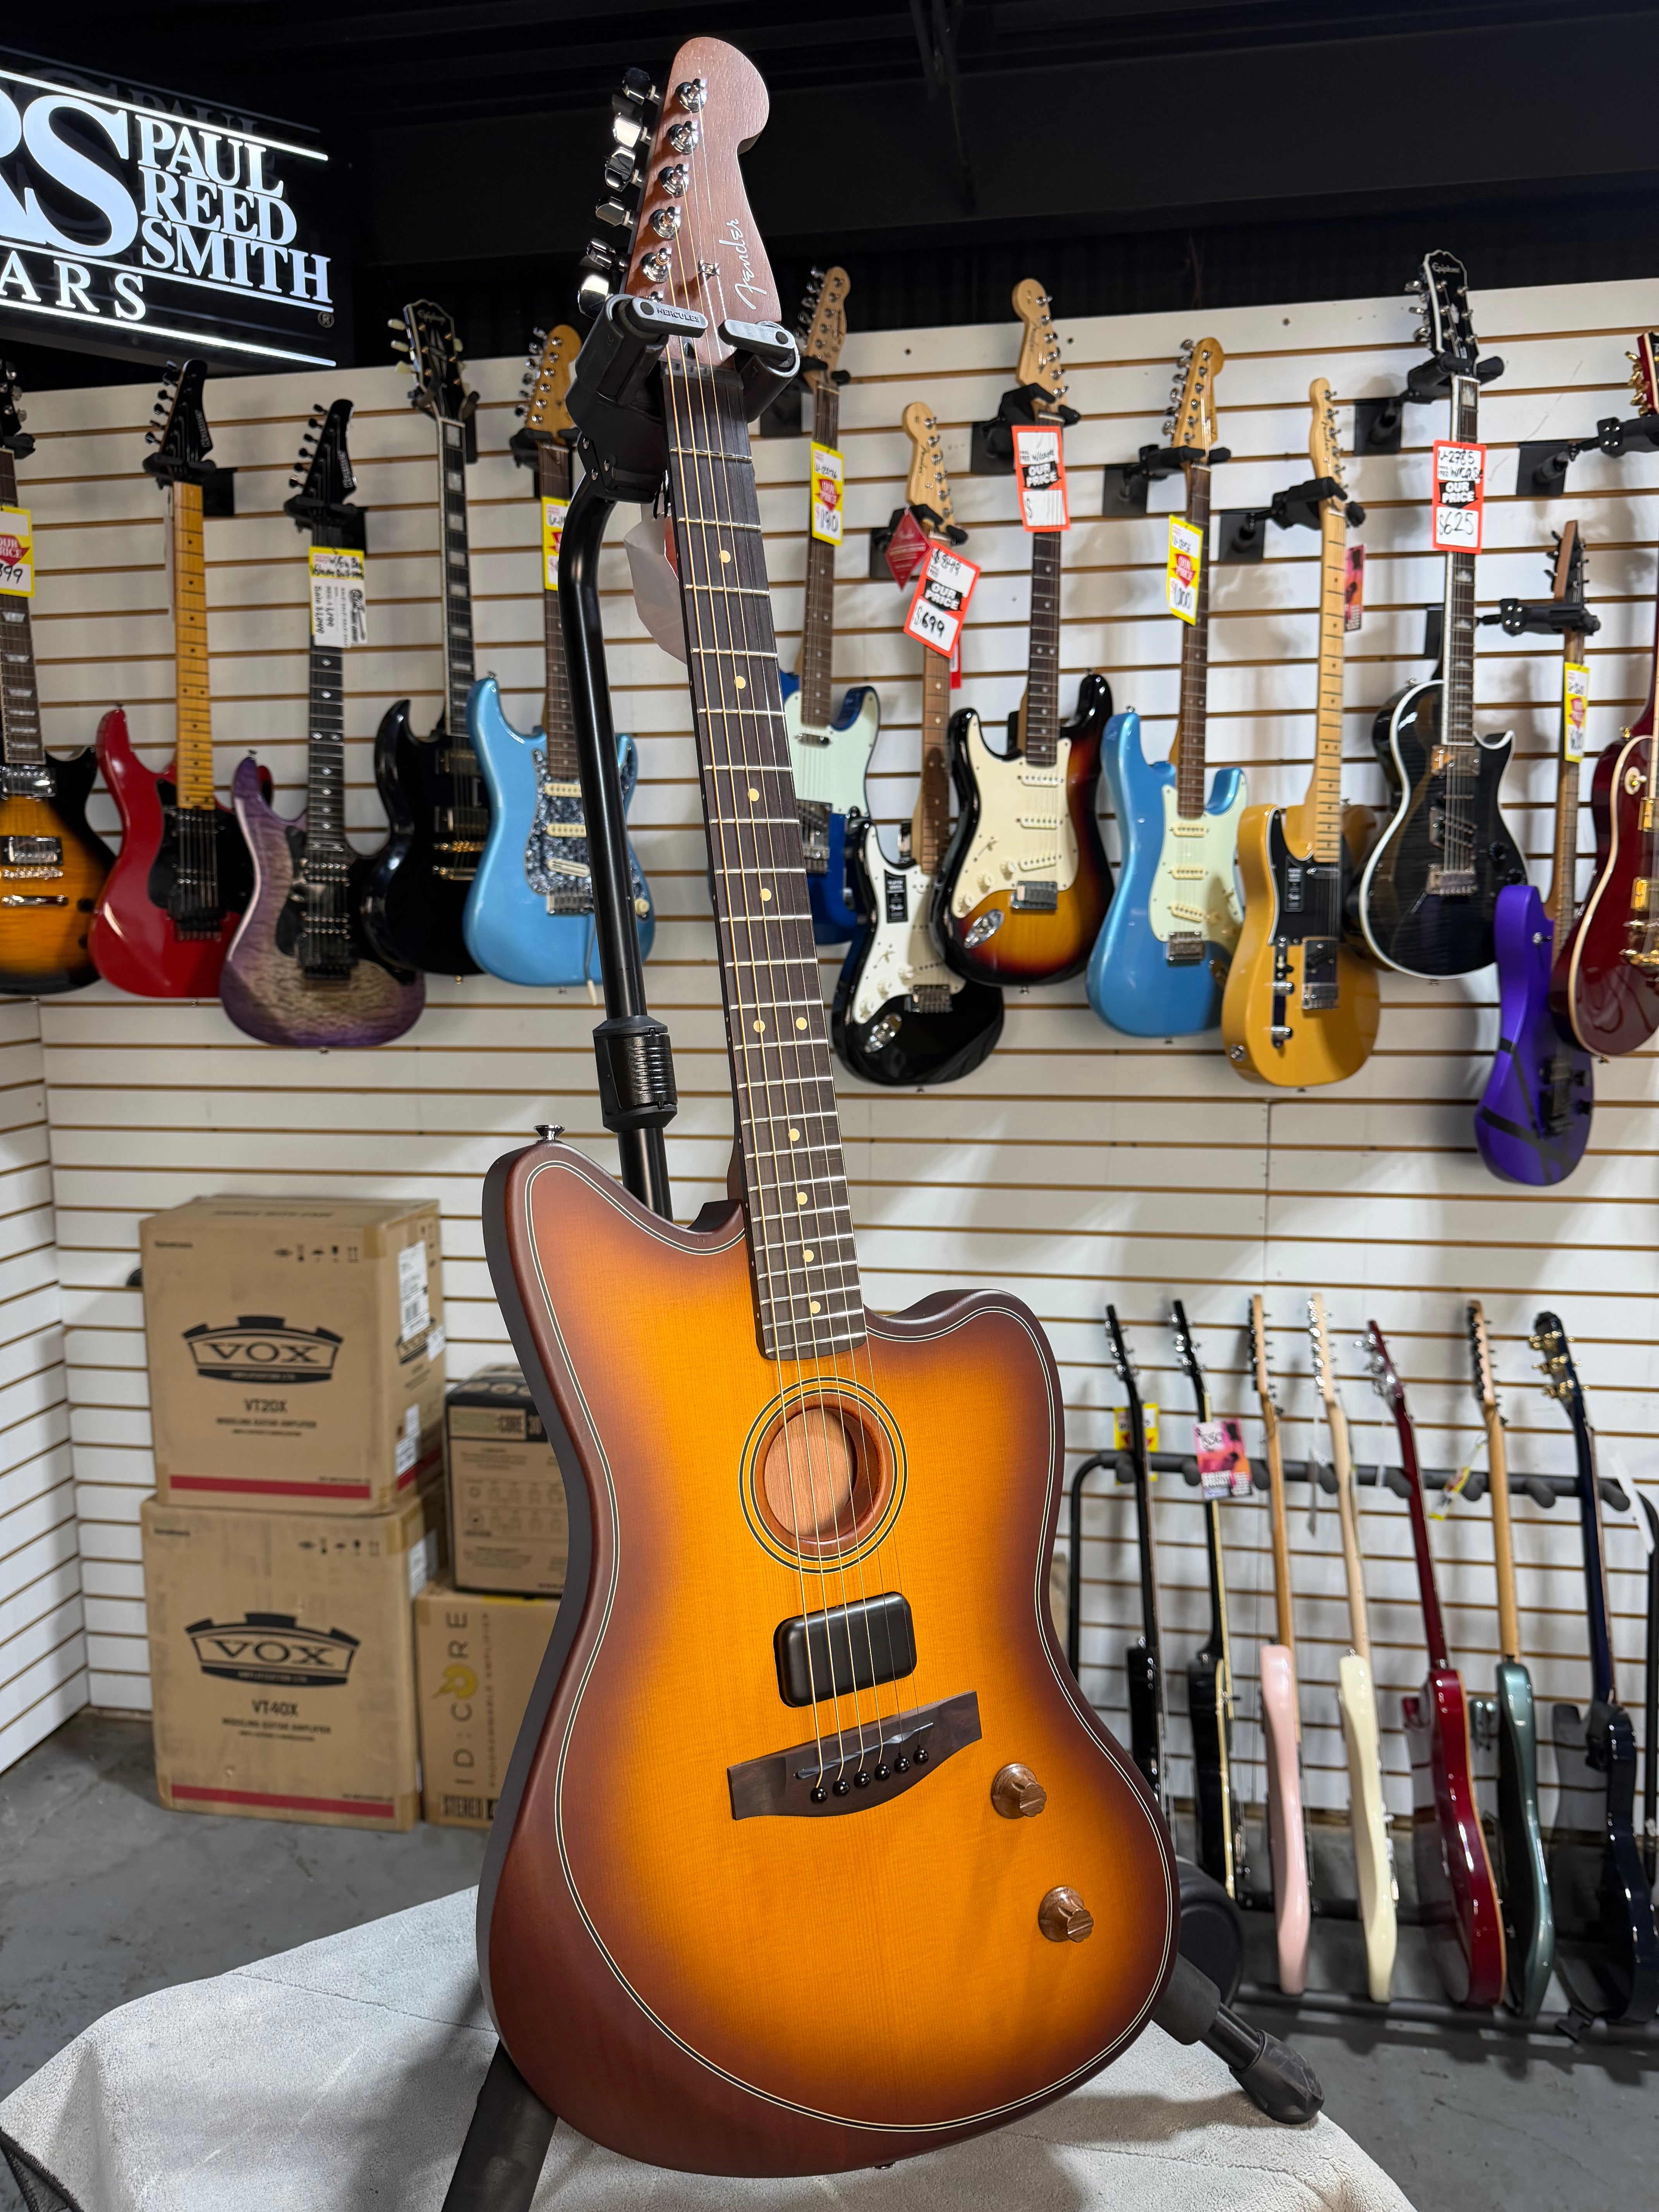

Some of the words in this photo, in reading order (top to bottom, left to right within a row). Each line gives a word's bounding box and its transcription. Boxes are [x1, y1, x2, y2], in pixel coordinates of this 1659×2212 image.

[136, 115, 284, 198] PAUL
[139, 166, 297, 246] REED
[142, 218, 333, 304] SMITH
[718, 218, 767, 310] Fender
[0, 251, 146, 321] ARS
[656, 307, 701, 323] HERCULES
[1025, 471, 1058, 488] PRICE
[1028, 463, 1051, 477] OUR
[1441, 491, 1475, 504] PRICE
[1446, 481, 1470, 493] OUR
[925, 589, 960, 611] PRICE
[931, 582, 957, 599] OUR
[204, 1341, 320, 1364] VOX
[209, 1639, 335, 1667] VOX
